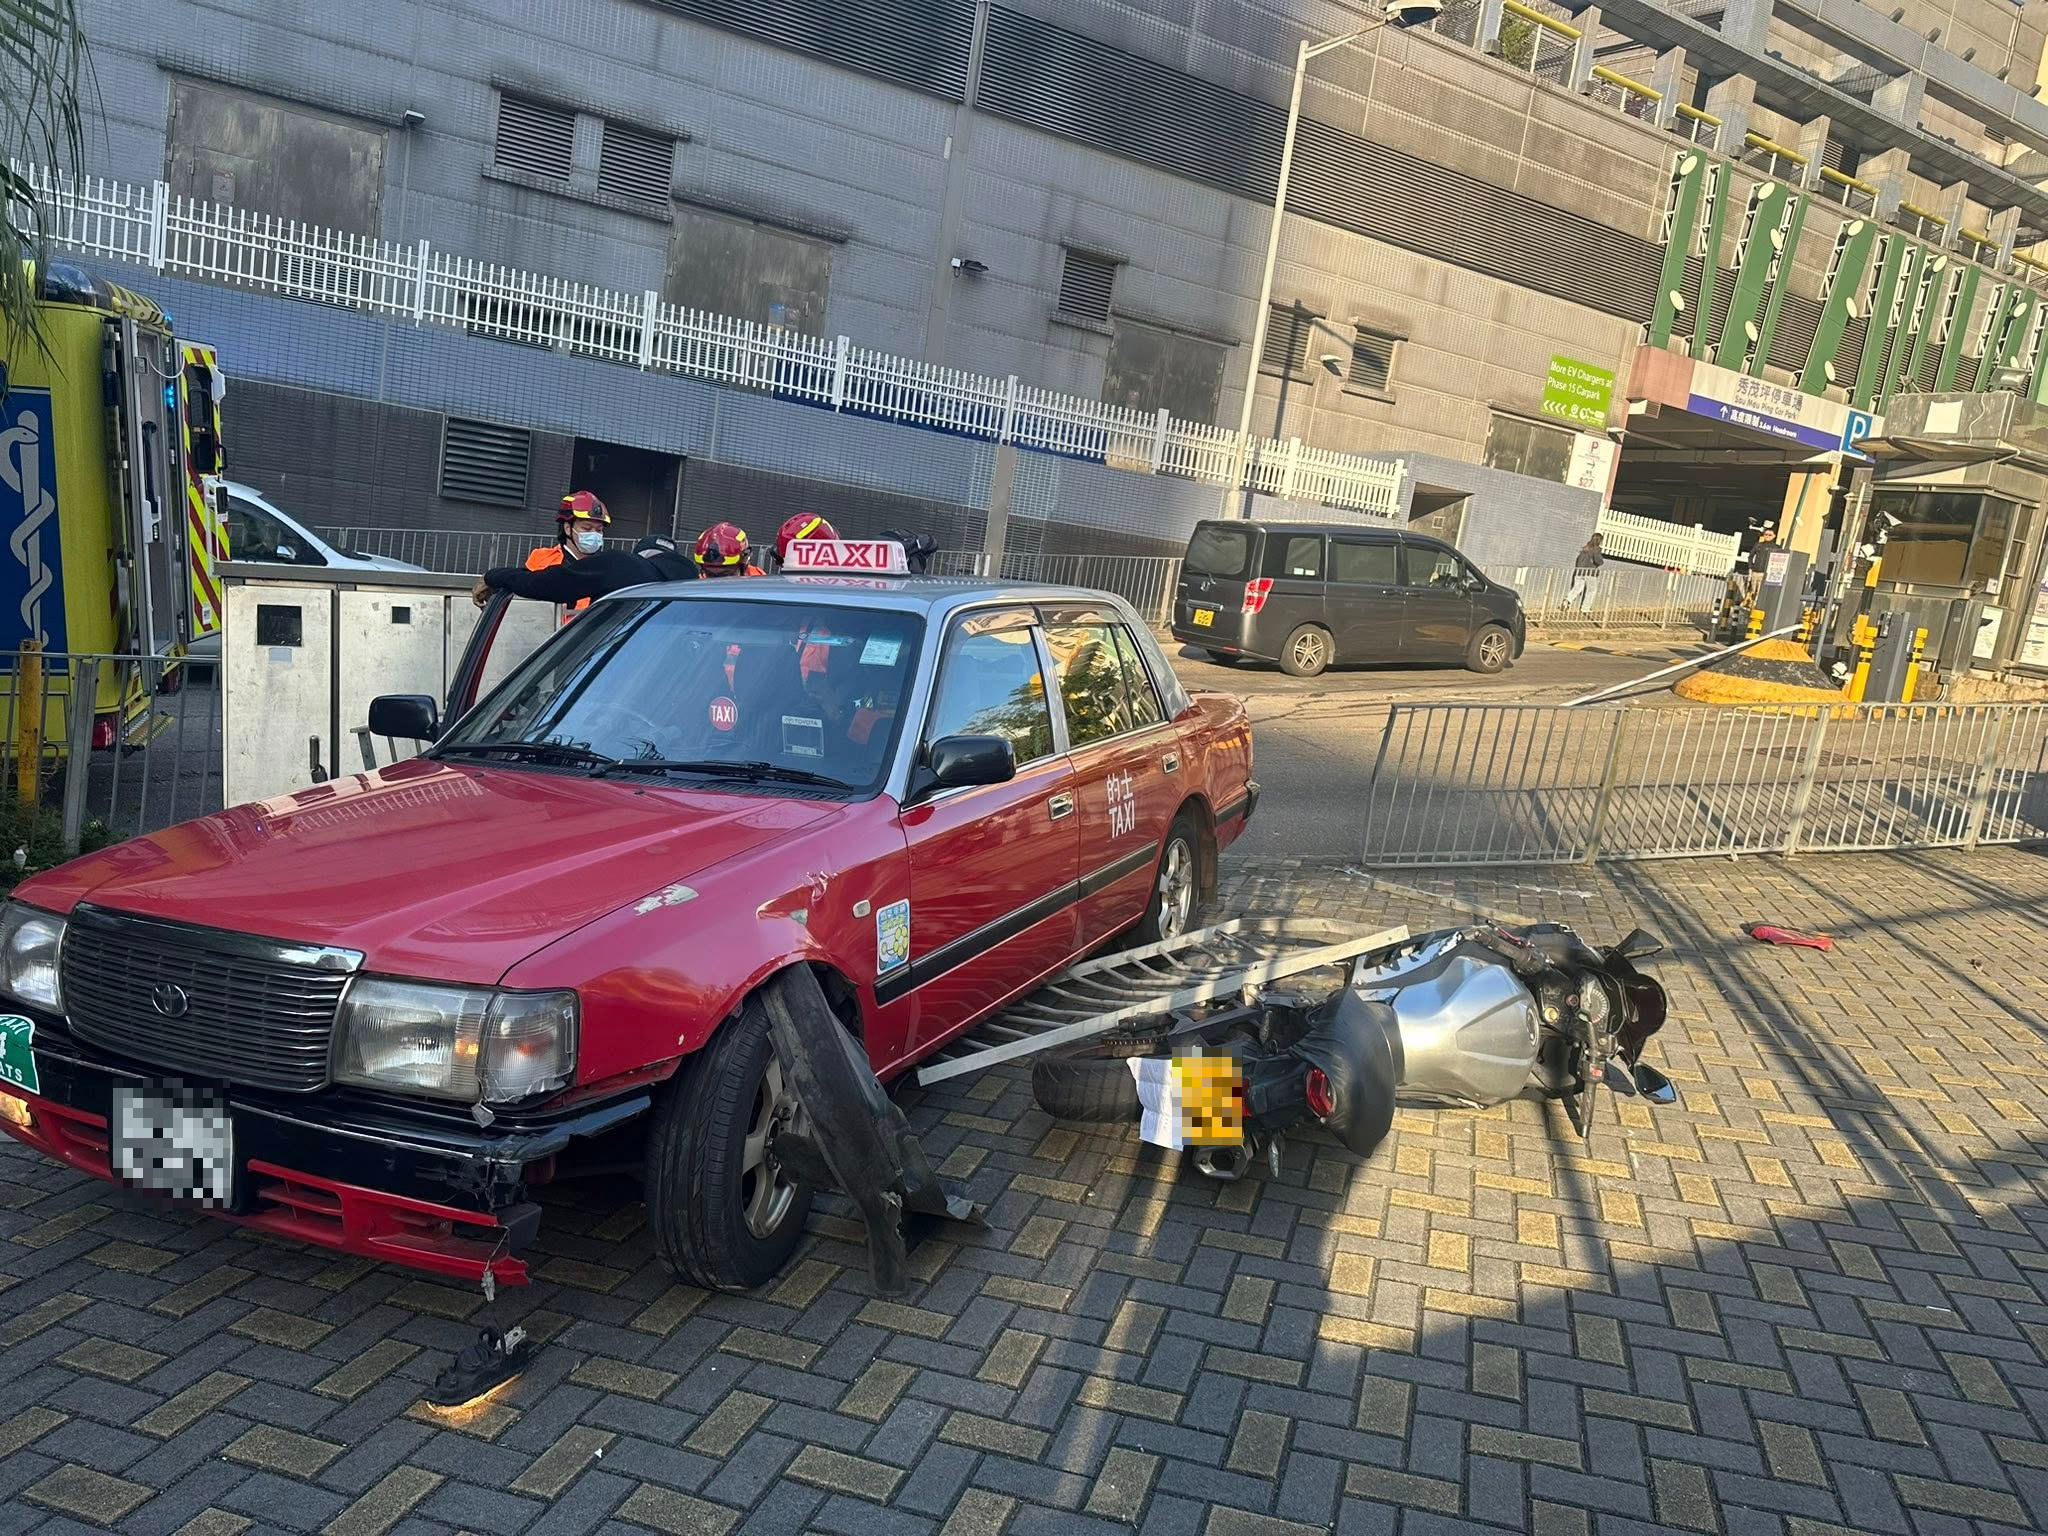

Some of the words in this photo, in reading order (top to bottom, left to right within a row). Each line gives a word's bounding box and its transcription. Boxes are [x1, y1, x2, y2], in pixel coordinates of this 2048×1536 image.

[1550, 360, 1567, 375] More
[1567, 366, 1578, 377] EV
[1578, 369, 1605, 386] Chargers
[1547, 376, 1567, 391] Phase
[1568, 382, 1577, 393] 15
[1576, 385, 1600, 400] Carpark
[1736, 377, 1804, 411] 秀茂坪停車場
[1761, 402, 1774, 415] Ping
[1774, 406, 1784, 416] Car
[1785, 409, 1797, 420] Park
[1848, 415, 1867, 449] P
[793, 542, 888, 568] TAXI
[710, 704, 735, 723] TAXI
[1106, 768, 1133, 805] 的士
[1108, 799, 1135, 838] TAXI
